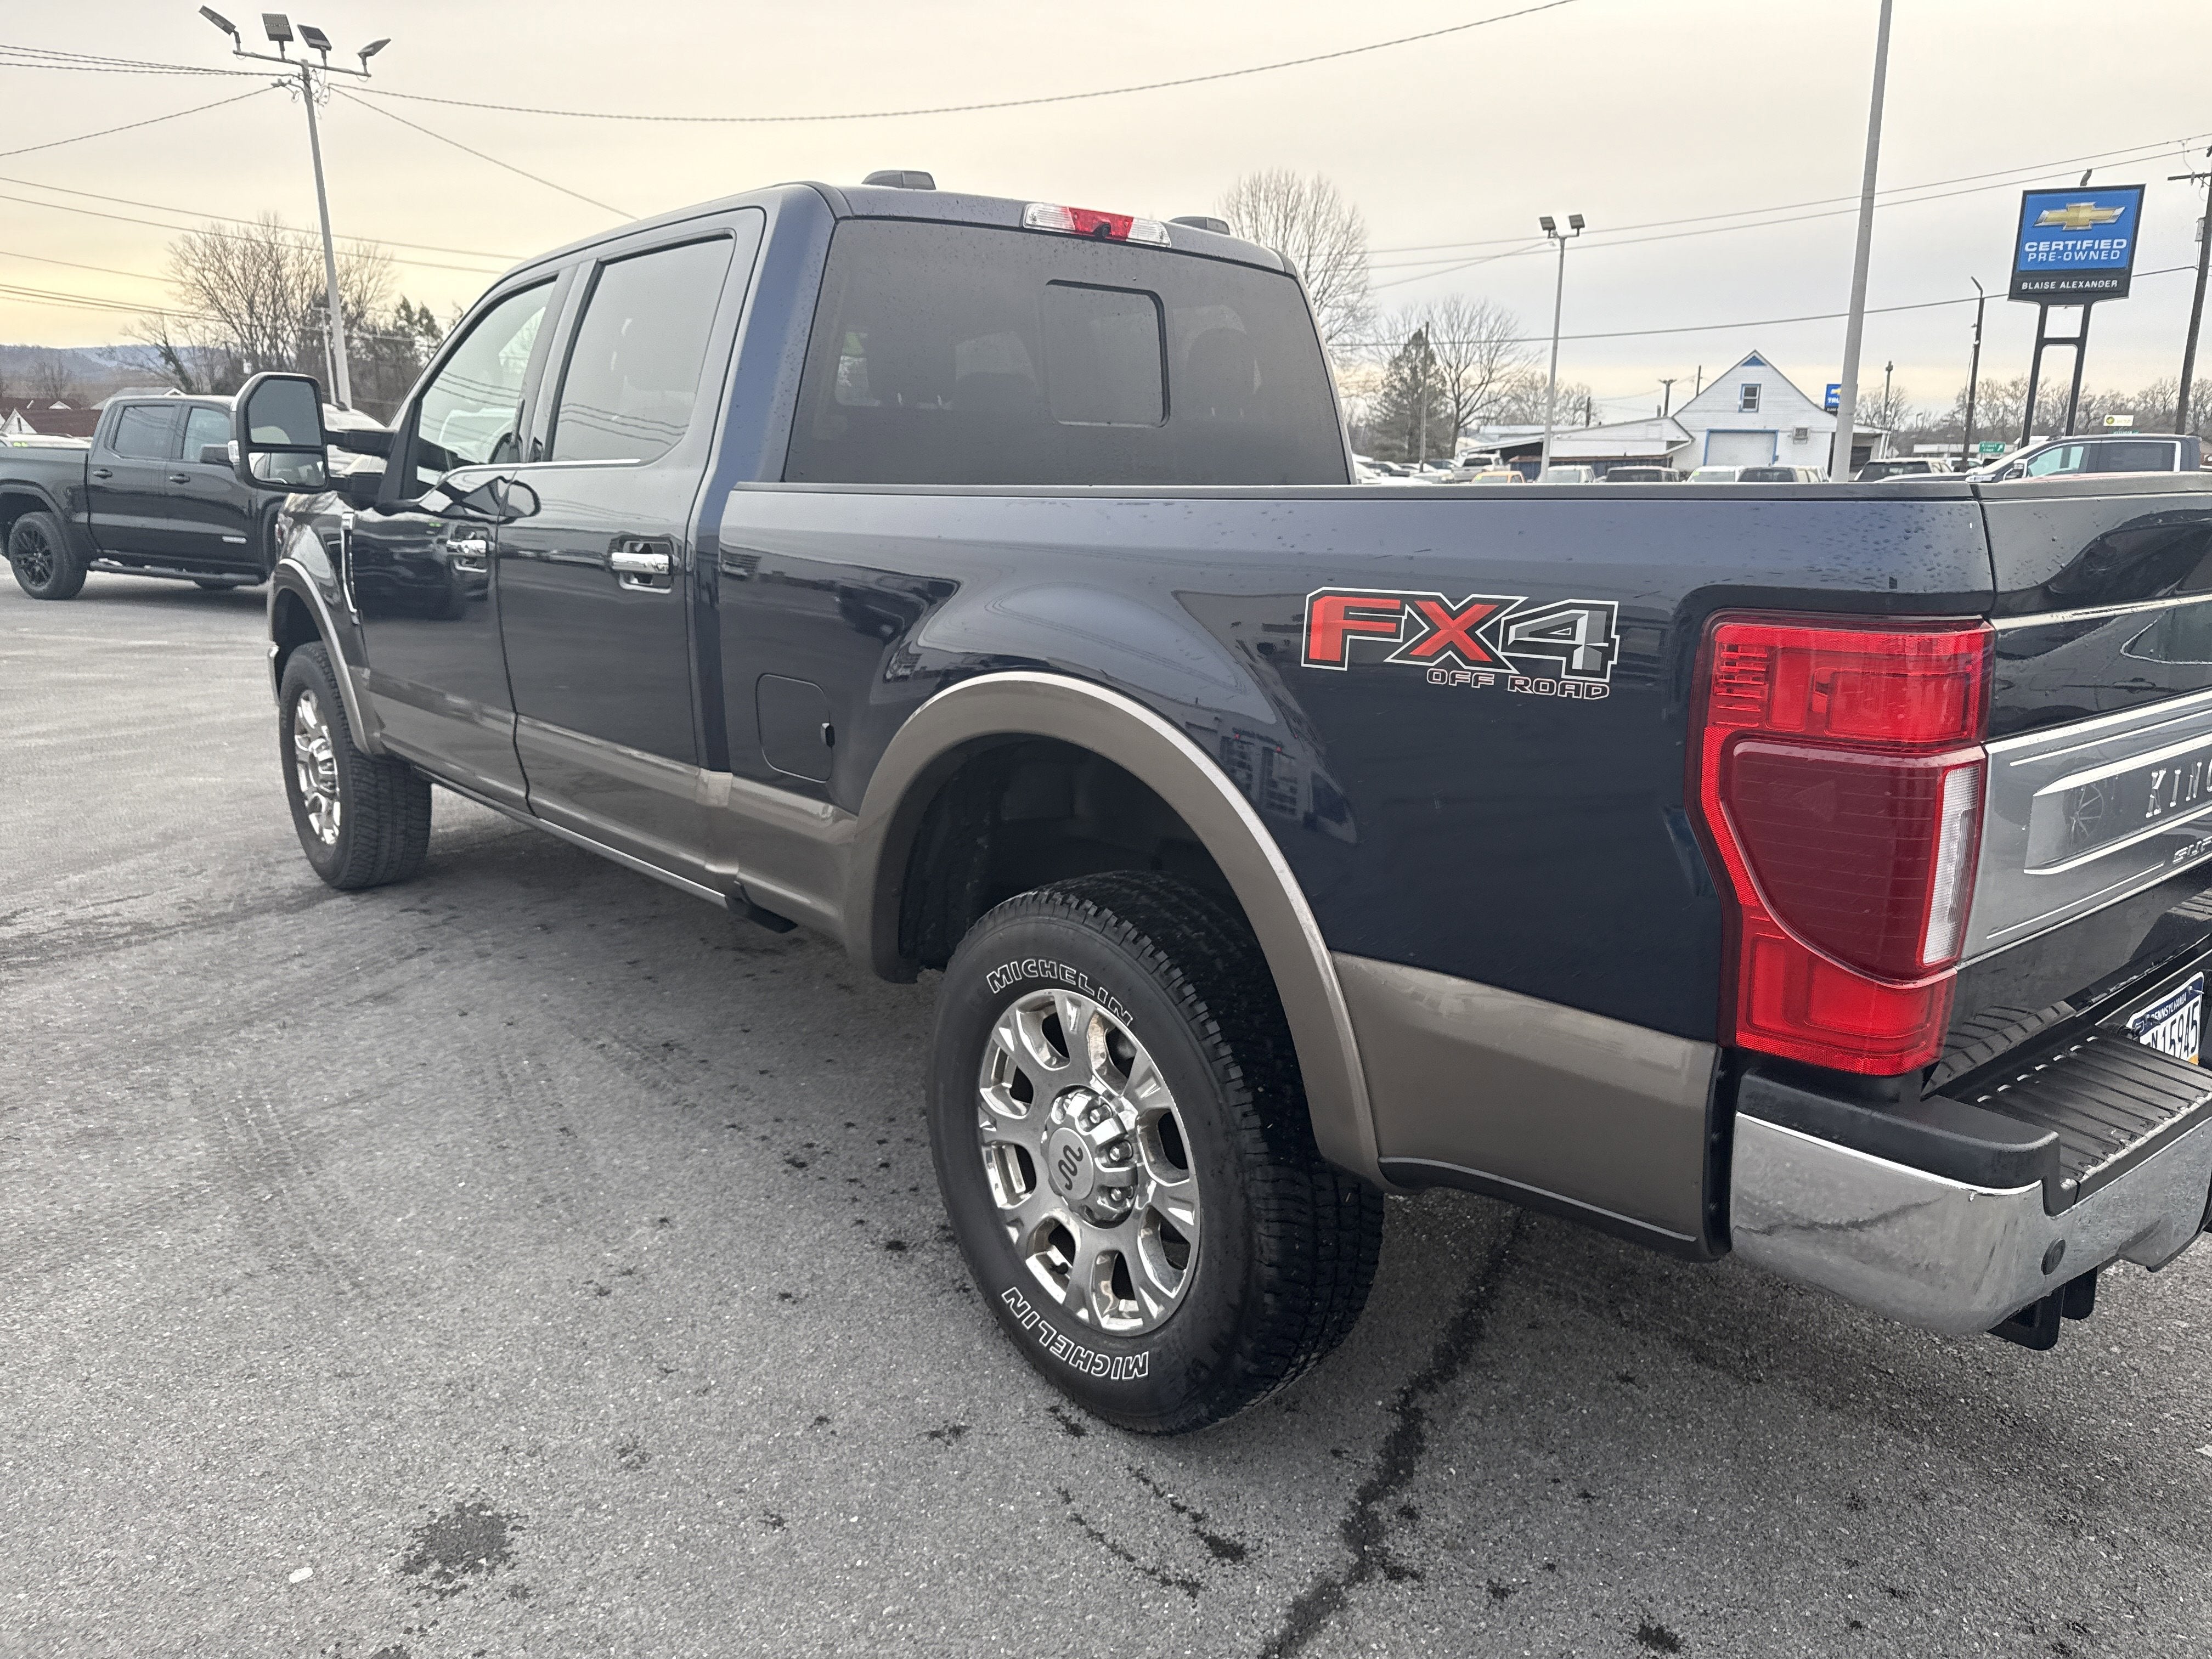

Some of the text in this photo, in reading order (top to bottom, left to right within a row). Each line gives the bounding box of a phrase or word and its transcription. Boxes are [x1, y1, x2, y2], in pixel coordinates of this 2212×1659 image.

[2024, 238, 2127, 252] CERTIFIED
[2027, 250, 2120, 262] PRE-OWNED
[2021, 280, 2118, 290] BLAISE ALEXANDER
[1301, 586, 1620, 682] FX4
[1426, 668, 1610, 701] OFF ROAD
[986, 958, 1135, 1027] MICHELIN
[1001, 1286, 1149, 1380] MICHELIN
